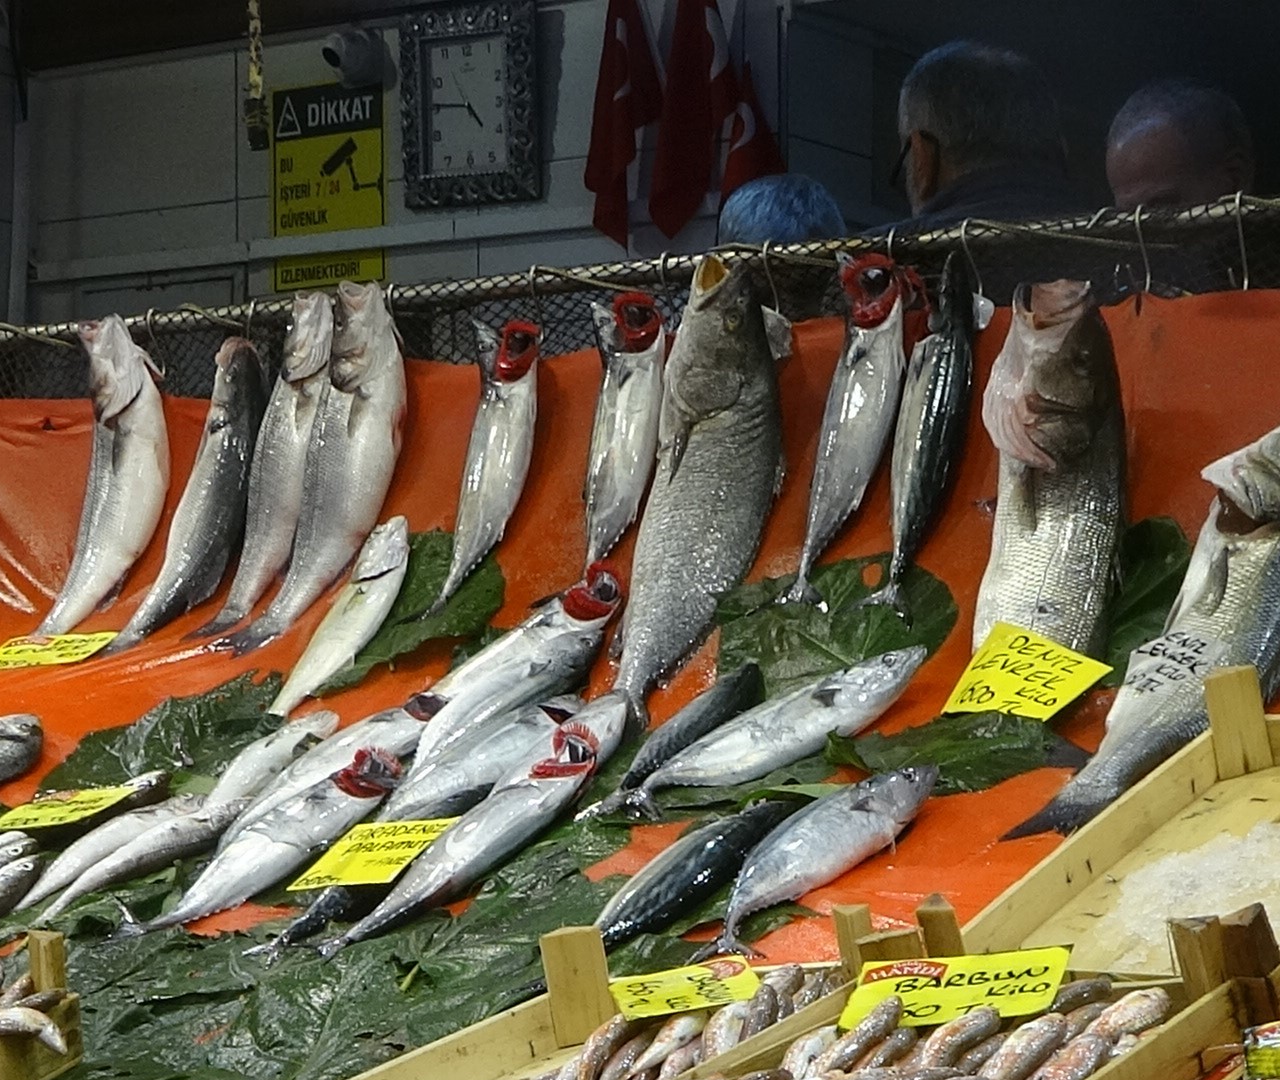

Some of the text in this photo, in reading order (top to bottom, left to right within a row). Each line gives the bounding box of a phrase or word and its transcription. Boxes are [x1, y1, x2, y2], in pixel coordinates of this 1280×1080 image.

[494, 69, 502, 82] 2
[495, 96, 503, 108] 3
[307, 95, 374, 127] DİKKAT
[495, 123, 503, 134] 4
[444, 155, 452, 168] 7
[488, 151, 496, 164] 5
[280, 158, 293, 173] BU
[280, 179, 311, 203] İŞYERİ
[280, 208, 328, 229] GÜVENLİK
[971, 650, 1067, 691] LEVREK
[894, 966, 1050, 994] BARBUN
